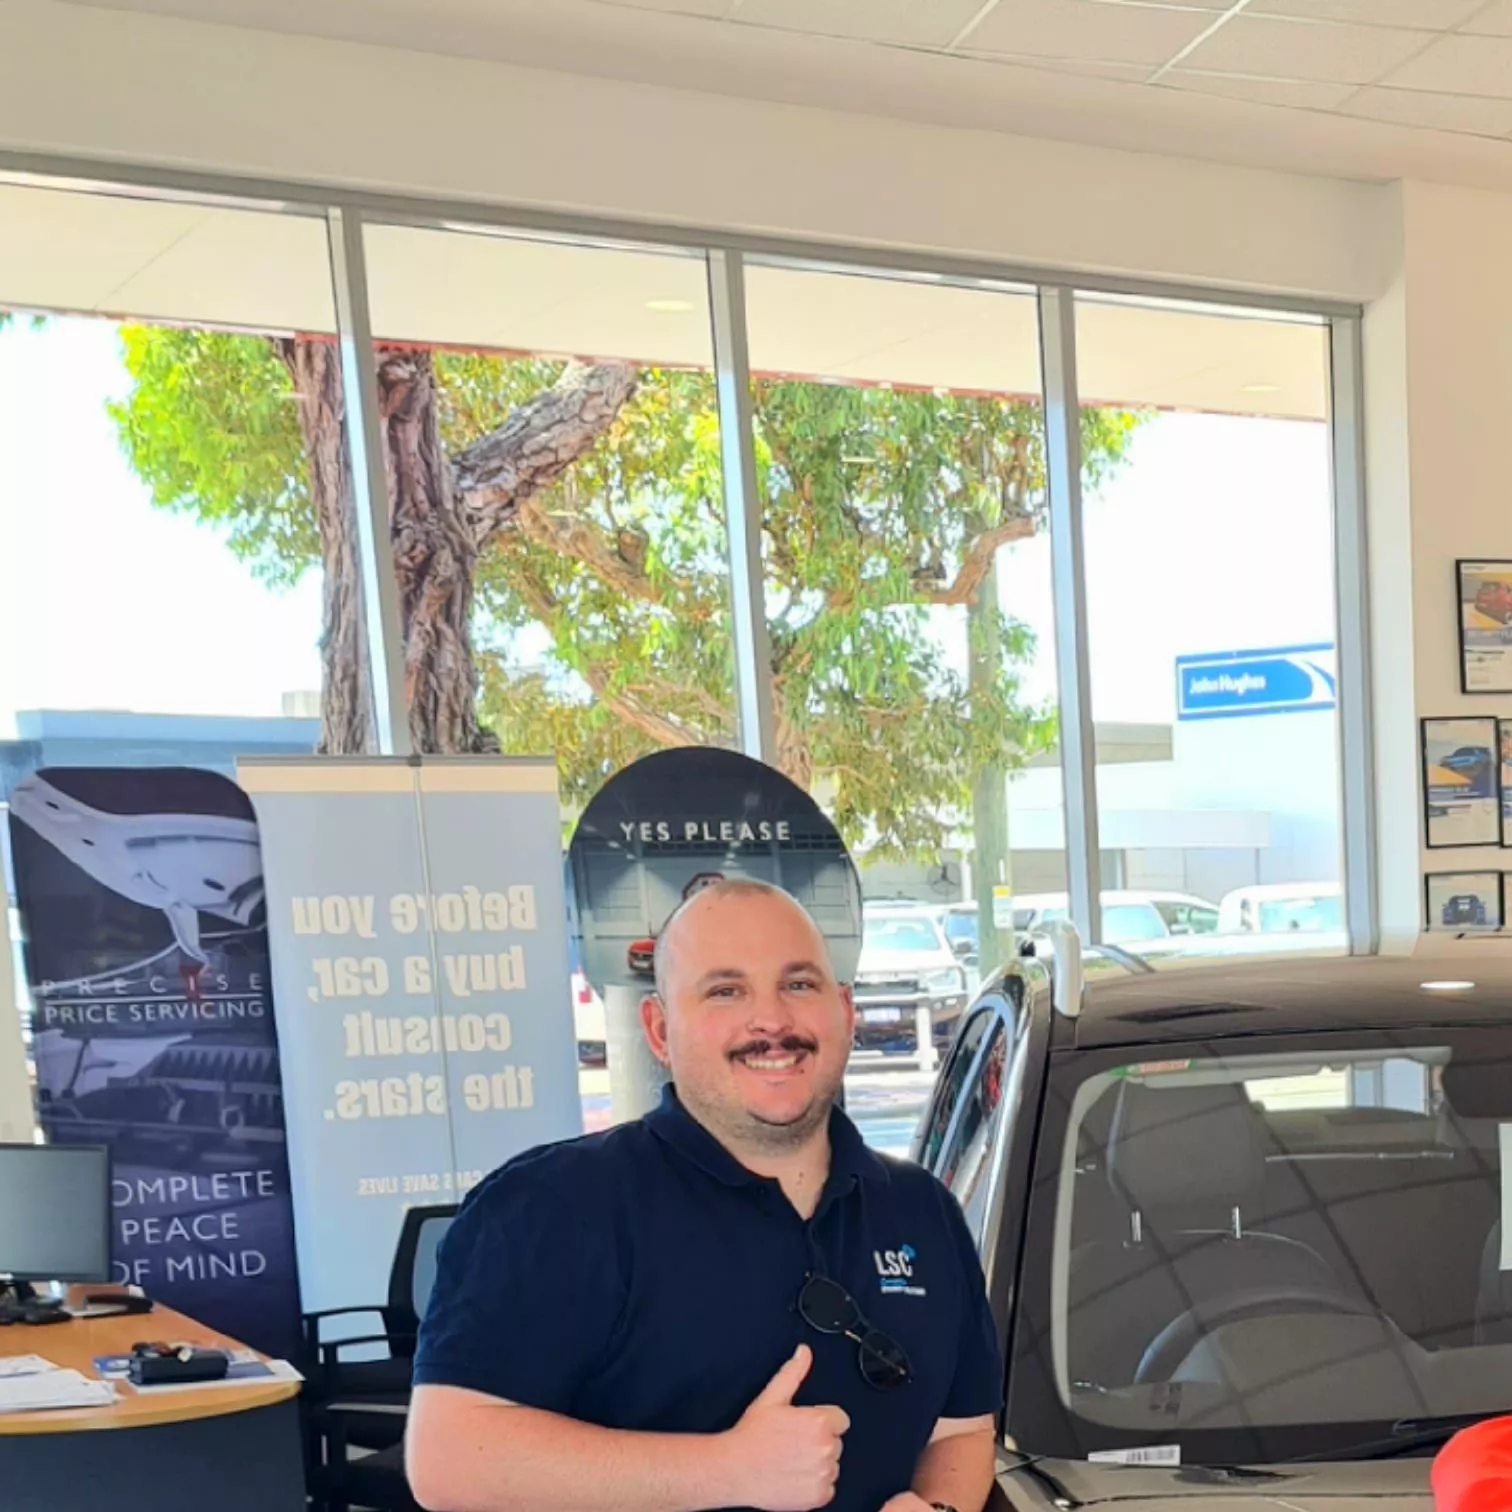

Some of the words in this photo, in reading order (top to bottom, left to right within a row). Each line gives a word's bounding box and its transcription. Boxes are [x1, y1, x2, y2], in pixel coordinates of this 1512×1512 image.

[619, 821, 670, 841] YES
[684, 821, 791, 841] PLEASE
[41, 973, 262, 995] PRECISE
[44, 1004, 119, 1024] PRICE
[128, 1001, 264, 1020] SERVICING
[112, 1170, 274, 1207] OMPLETE
[121, 1212, 239, 1245] PEACE
[166, 1250, 266, 1282] MIND
[873, 1249, 913, 1277] LSC
